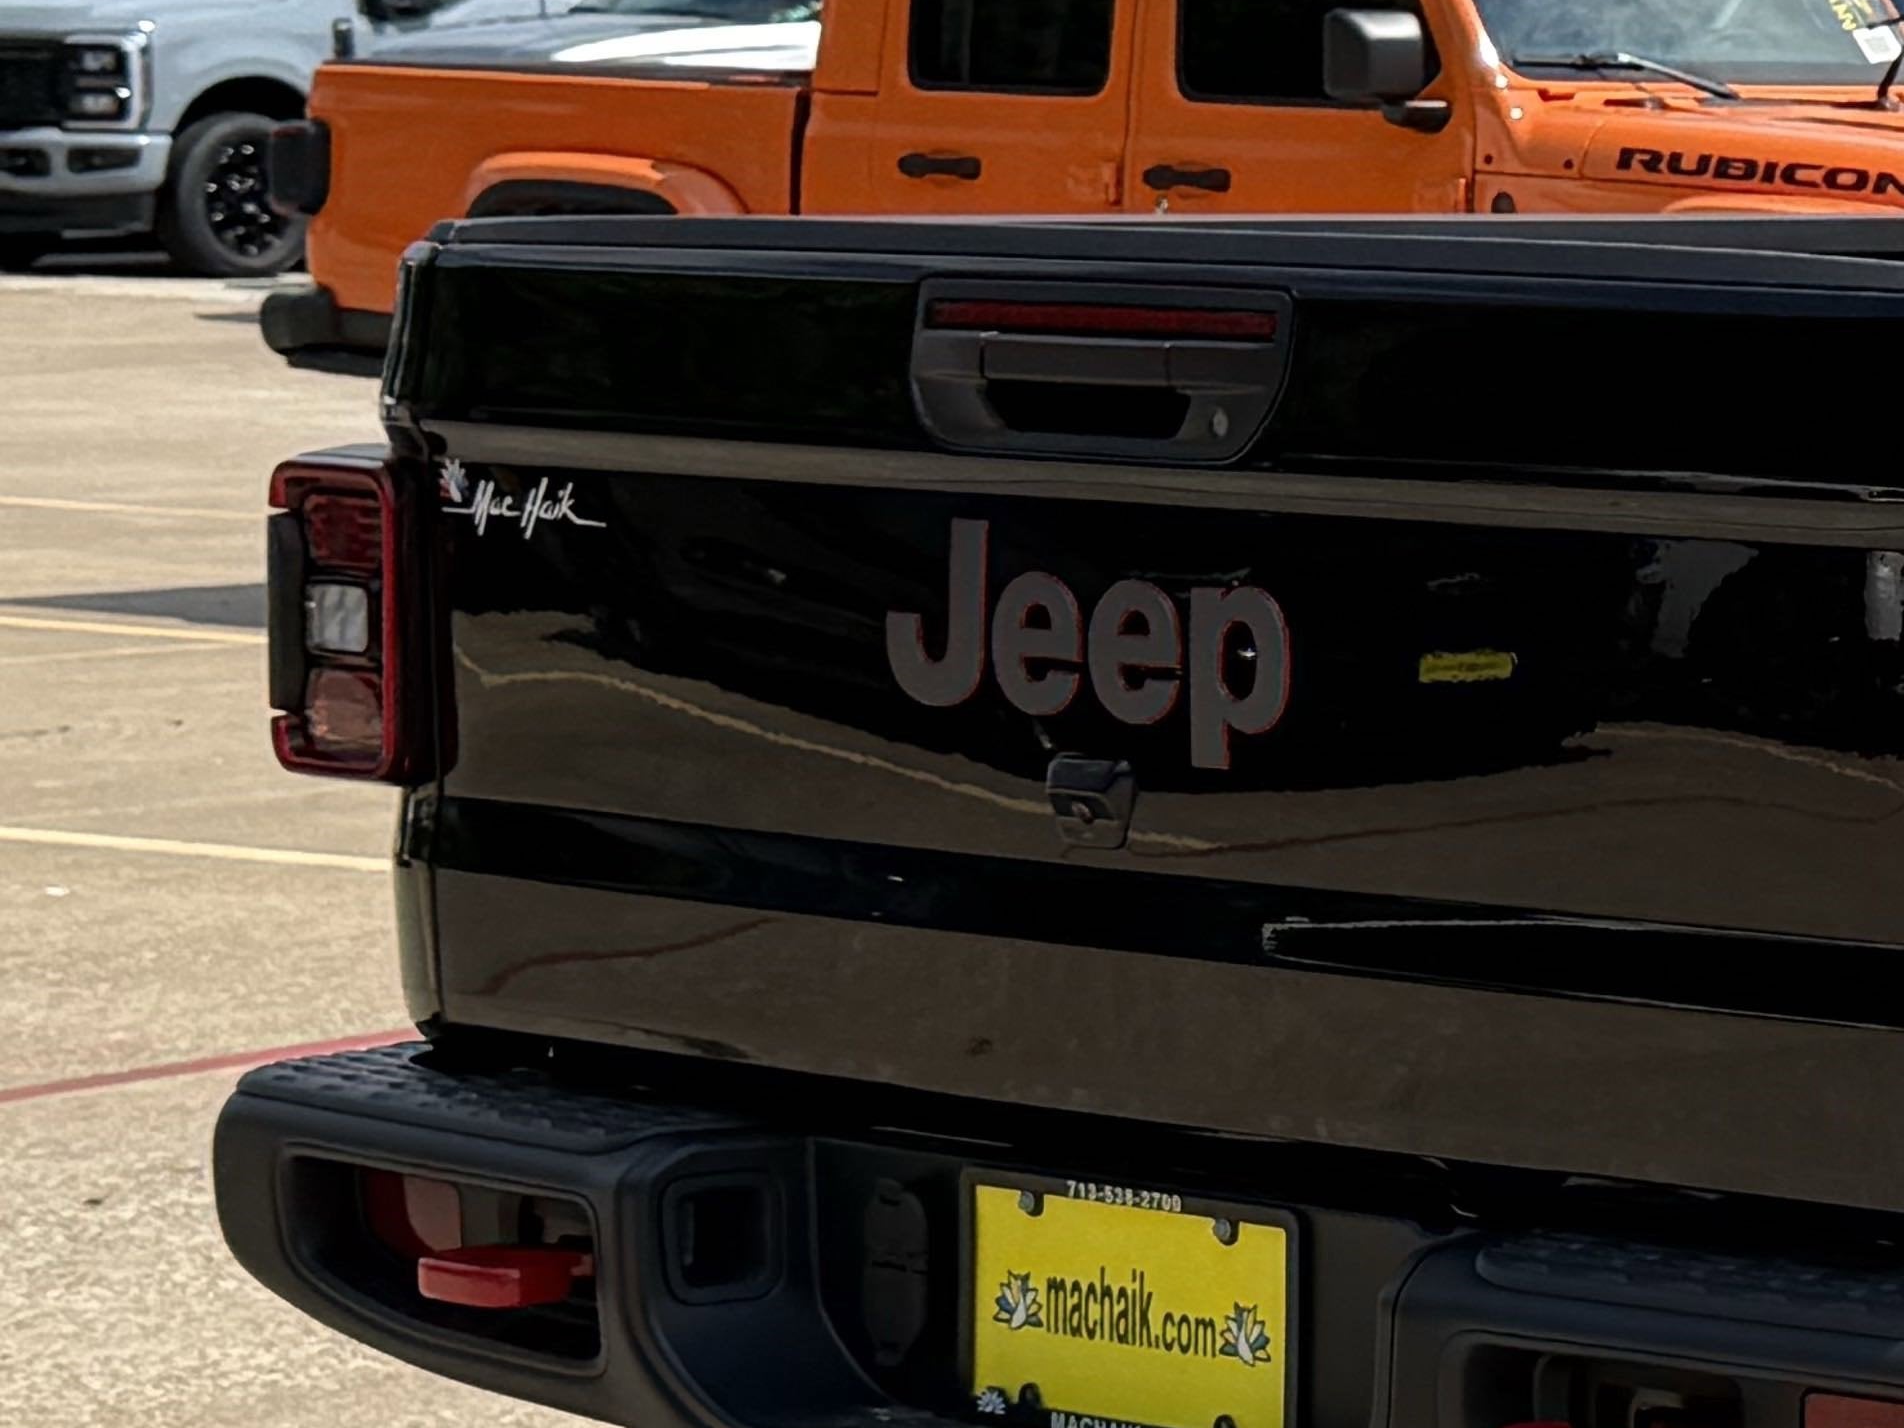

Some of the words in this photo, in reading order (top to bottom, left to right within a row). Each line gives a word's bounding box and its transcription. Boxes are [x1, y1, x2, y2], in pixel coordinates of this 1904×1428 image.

[442, 479, 521, 536] Mac
[520, 477, 607, 540] Haik
[885, 517, 1291, 770] Jeep
[1045, 1266, 1217, 1358] machaik.com
